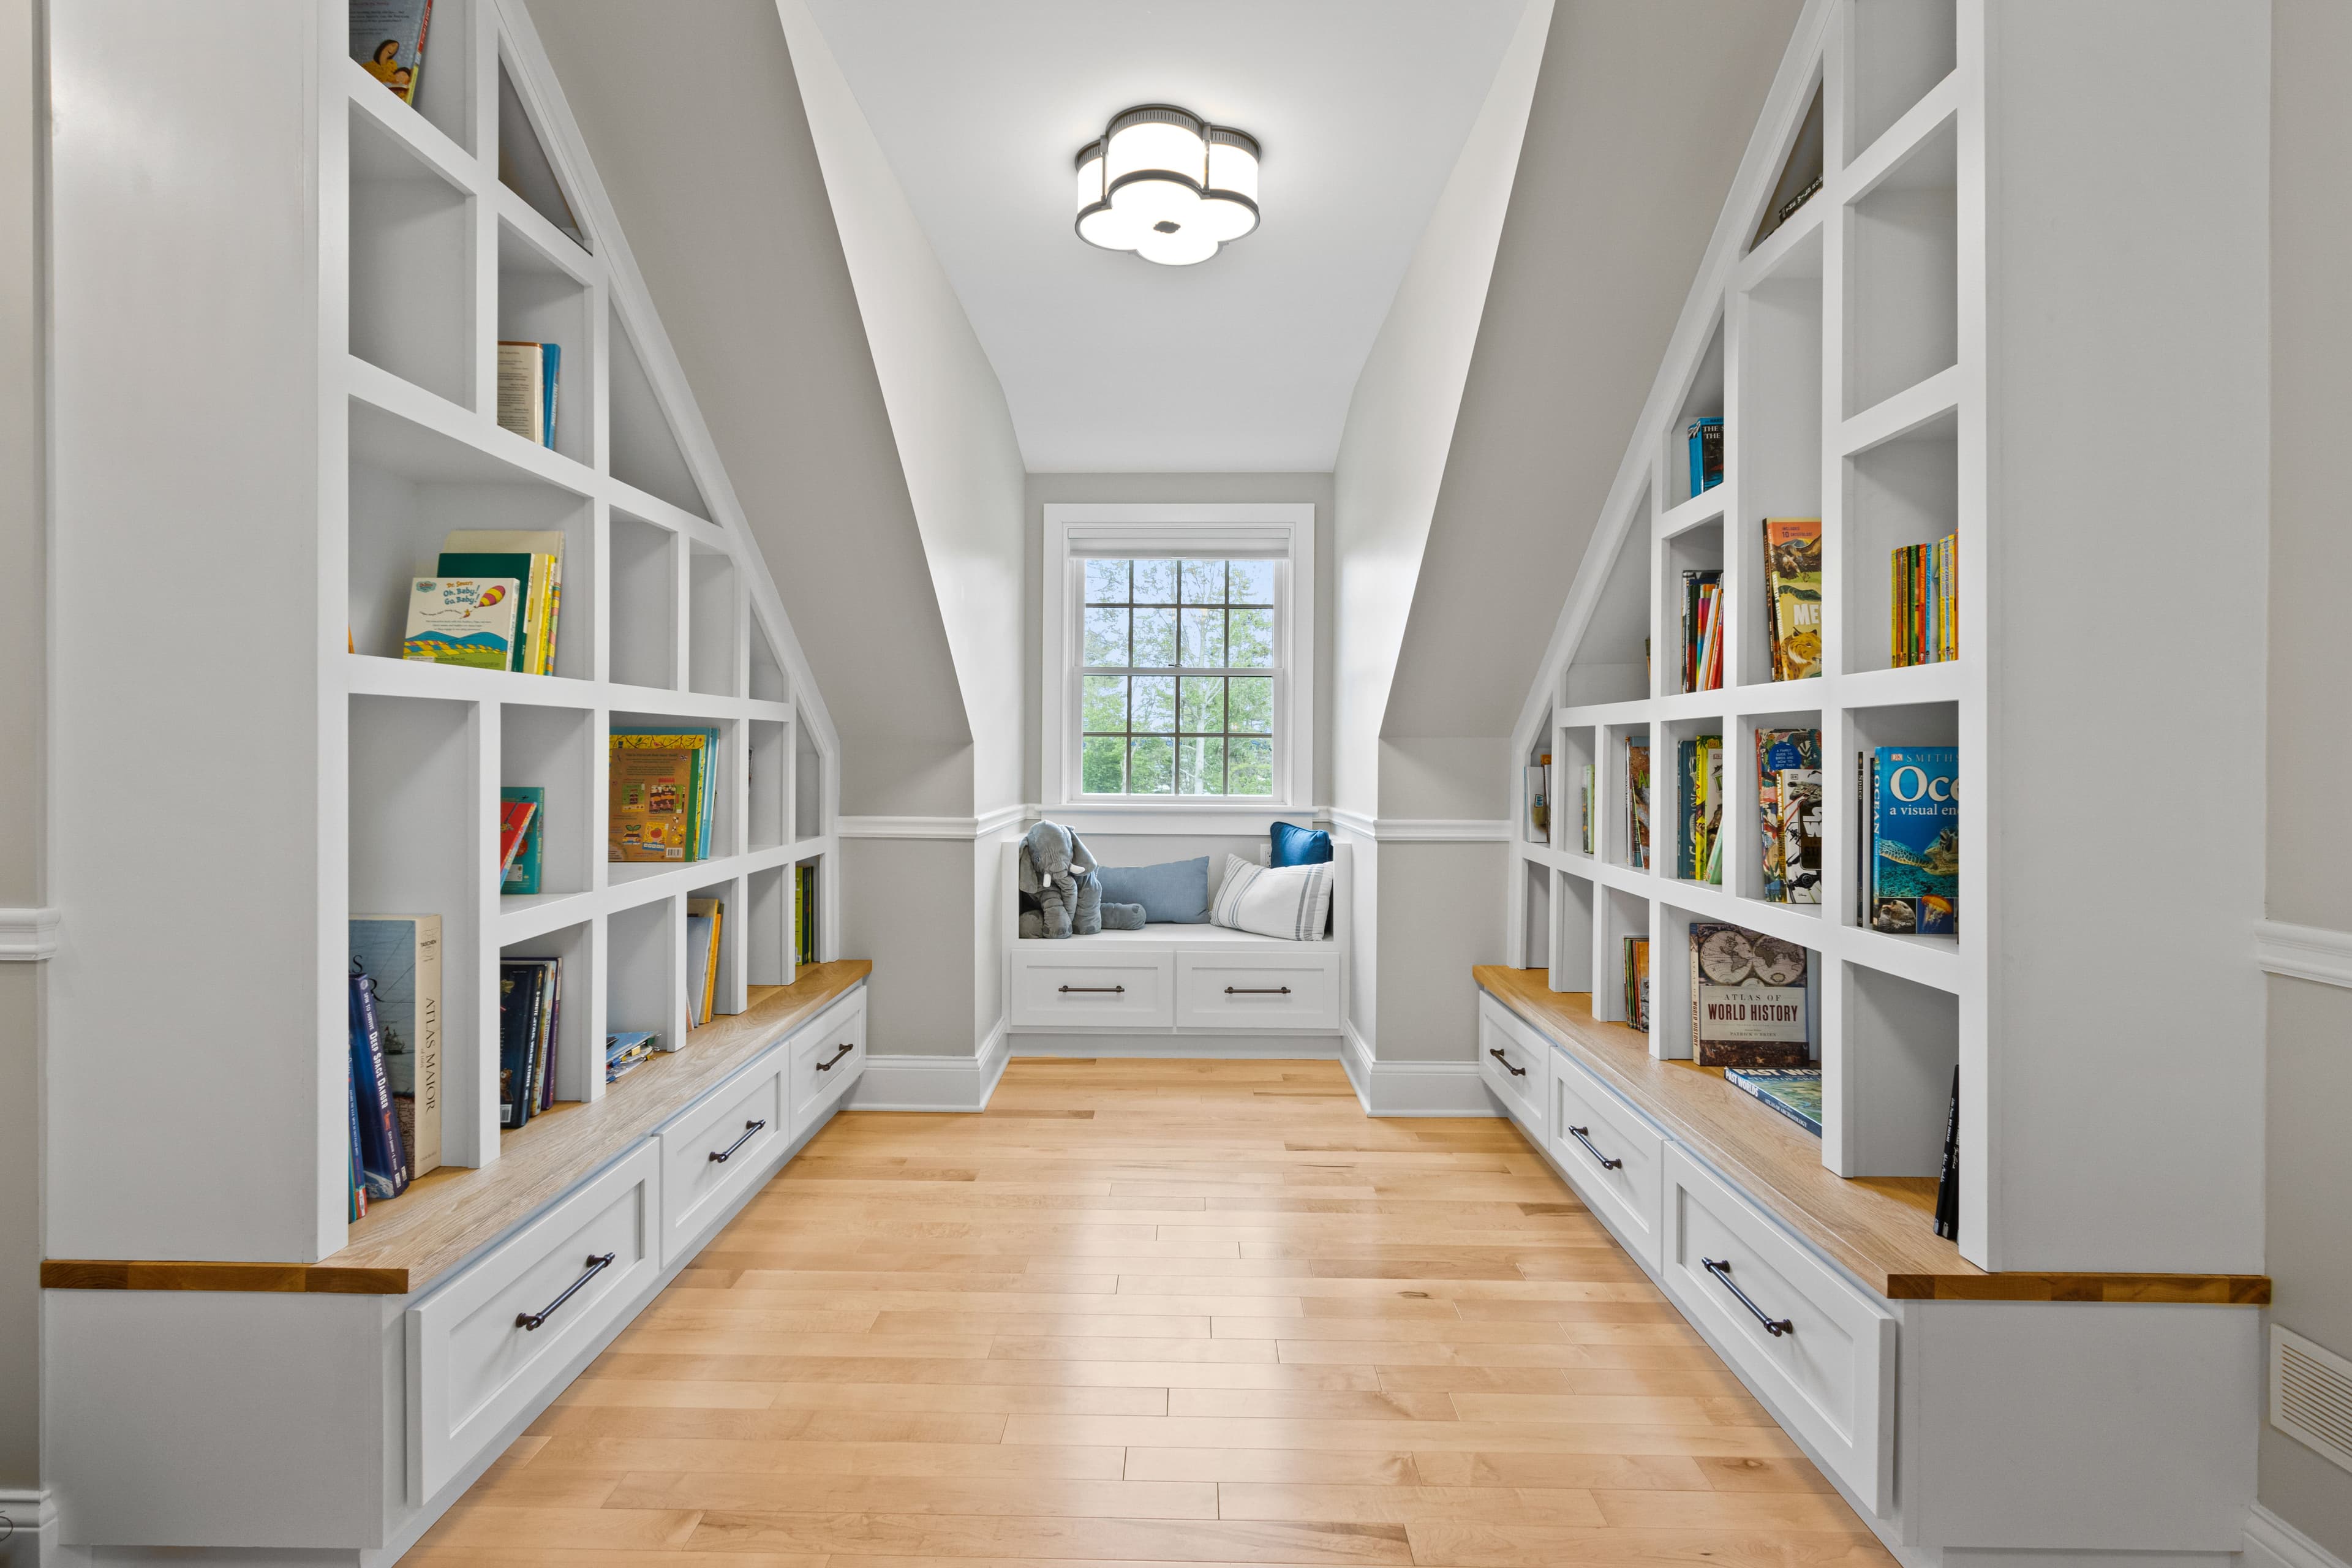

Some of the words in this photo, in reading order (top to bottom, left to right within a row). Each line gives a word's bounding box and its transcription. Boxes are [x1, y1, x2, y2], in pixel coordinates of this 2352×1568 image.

[456, 585, 480, 596] Baby!
[456, 594, 480, 605] Baby!
[1793, 603, 1822, 625] ME
[1901, 804, 1937, 815] visual
[1942, 807, 1958, 815] en
[426, 998, 435, 1049] ATLAS
[1708, 1003, 1746, 1020] WORLD
[1751, 1005, 1798, 1022] HISTORY
[369, 1031, 379, 1051] DEEP
[373, 1052, 383, 1079] SPACE
[377, 1077, 389, 1109] DANGER
[426, 1054, 435, 1114] MAIOR
[1725, 1070, 1738, 1085] PAST
[1738, 1077, 1758, 1098] WORLDS
